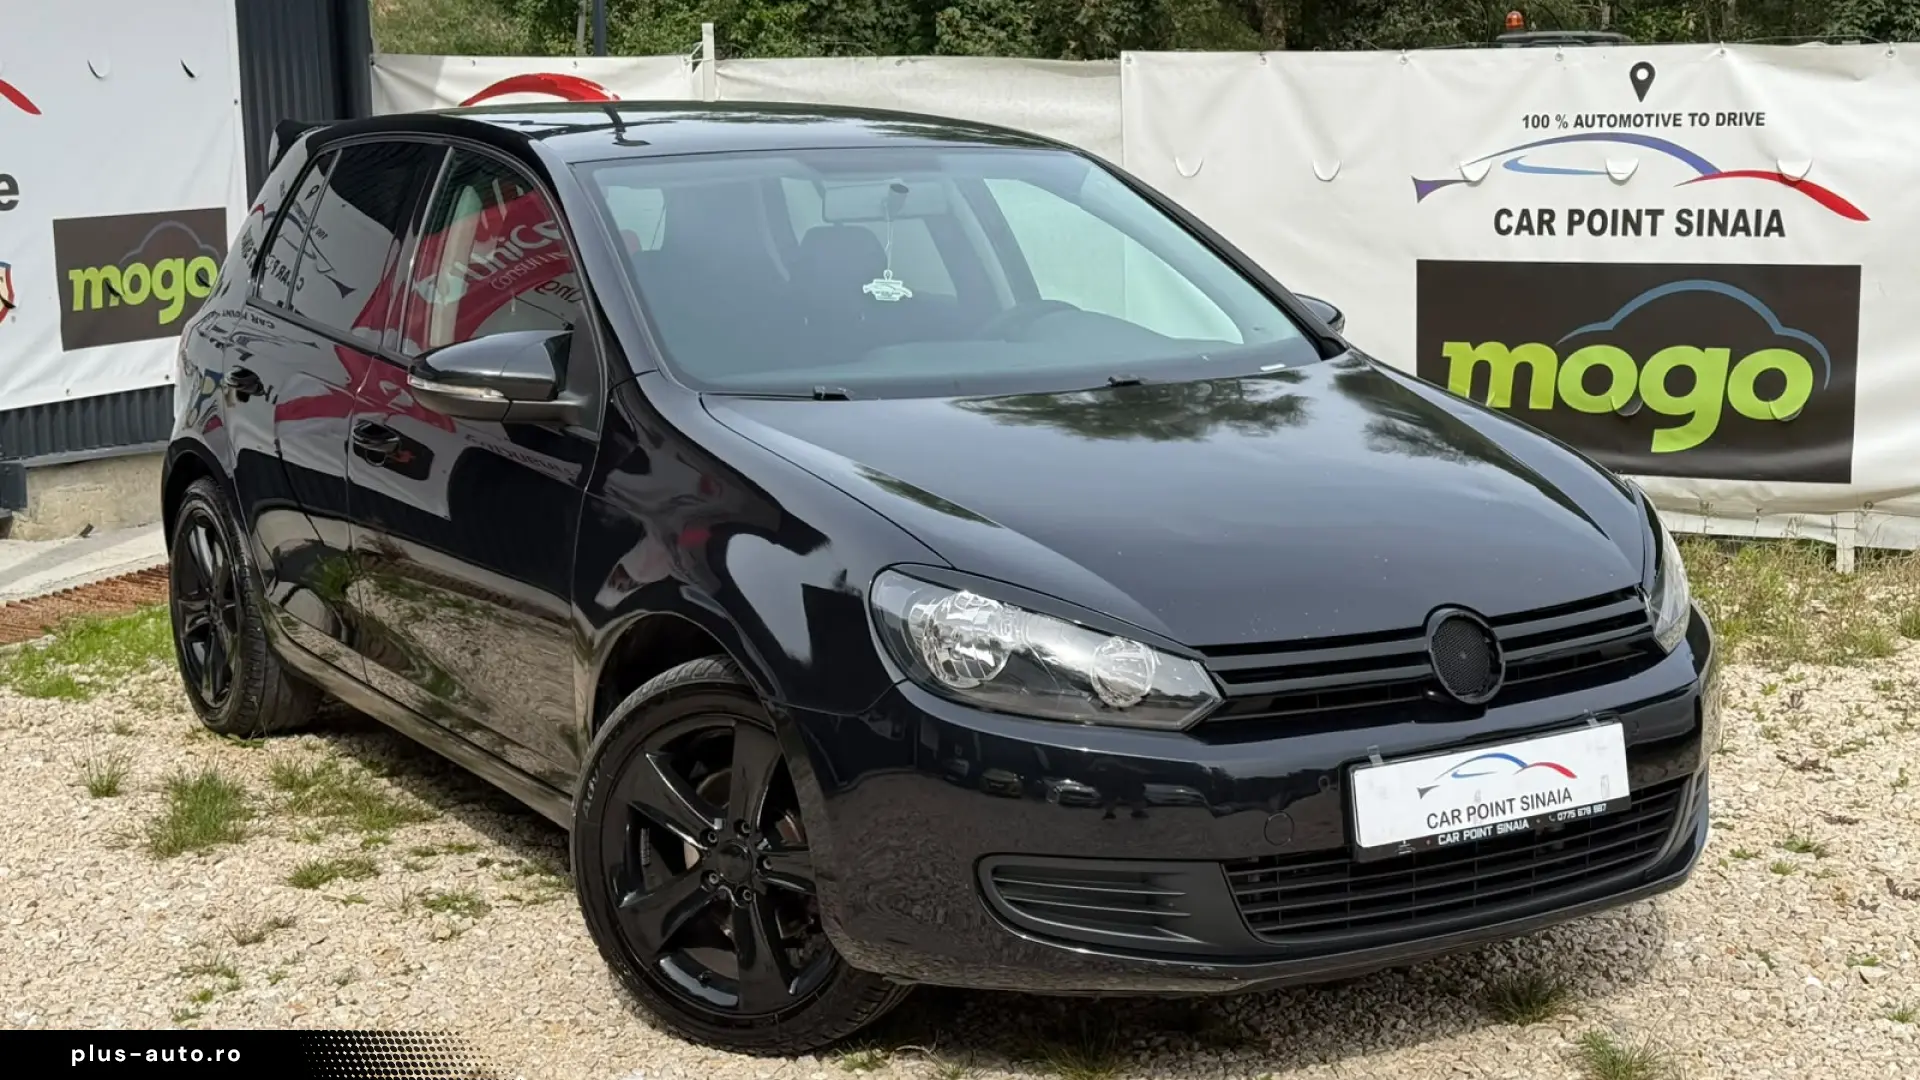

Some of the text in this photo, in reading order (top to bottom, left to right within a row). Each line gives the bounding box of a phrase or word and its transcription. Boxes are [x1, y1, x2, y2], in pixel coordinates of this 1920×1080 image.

[1522, 111, 1766, 129] 100 % AUTOMOTIVE TO DRIVE
[1493, 208, 1786, 238] CAR POINT SINAIA
[68, 255, 218, 325] mogo
[1441, 339, 1814, 454] mogo
[1426, 787, 1573, 830] CAR POINT SINAIA
[1438, 818, 1530, 846] CAR POINT SINAIA
